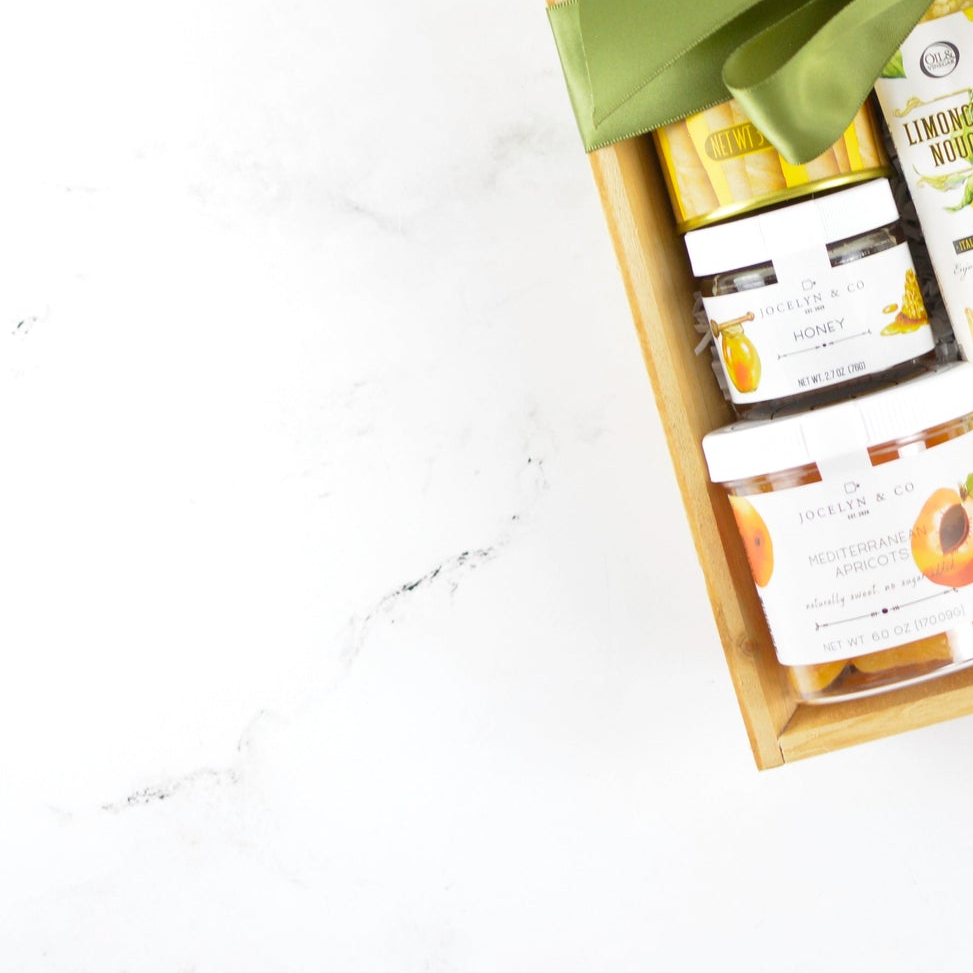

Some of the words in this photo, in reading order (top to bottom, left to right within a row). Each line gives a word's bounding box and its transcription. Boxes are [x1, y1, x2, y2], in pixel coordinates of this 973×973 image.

[710, 131, 733, 158] NET
[732, 125, 754, 150] WT
[760, 293, 822, 318] JOCELYN
[831, 289, 839, 298] &
[847, 280, 865, 292] CO
[793, 318, 845, 341] HONEY
[799, 496, 867, 524] JOCELYN
[876, 493, 885, 502] &
[894, 482, 915, 496] CO
[808, 525, 928, 567] MEDITERRANEAN
[835, 548, 910, 579] APRICOTS
[806, 593, 846, 611] naturally
[901, 573, 925, 589] sugar
[823, 640, 842, 653] NET
[847, 635, 865, 647] WT
[893, 623, 911, 636] OZ
